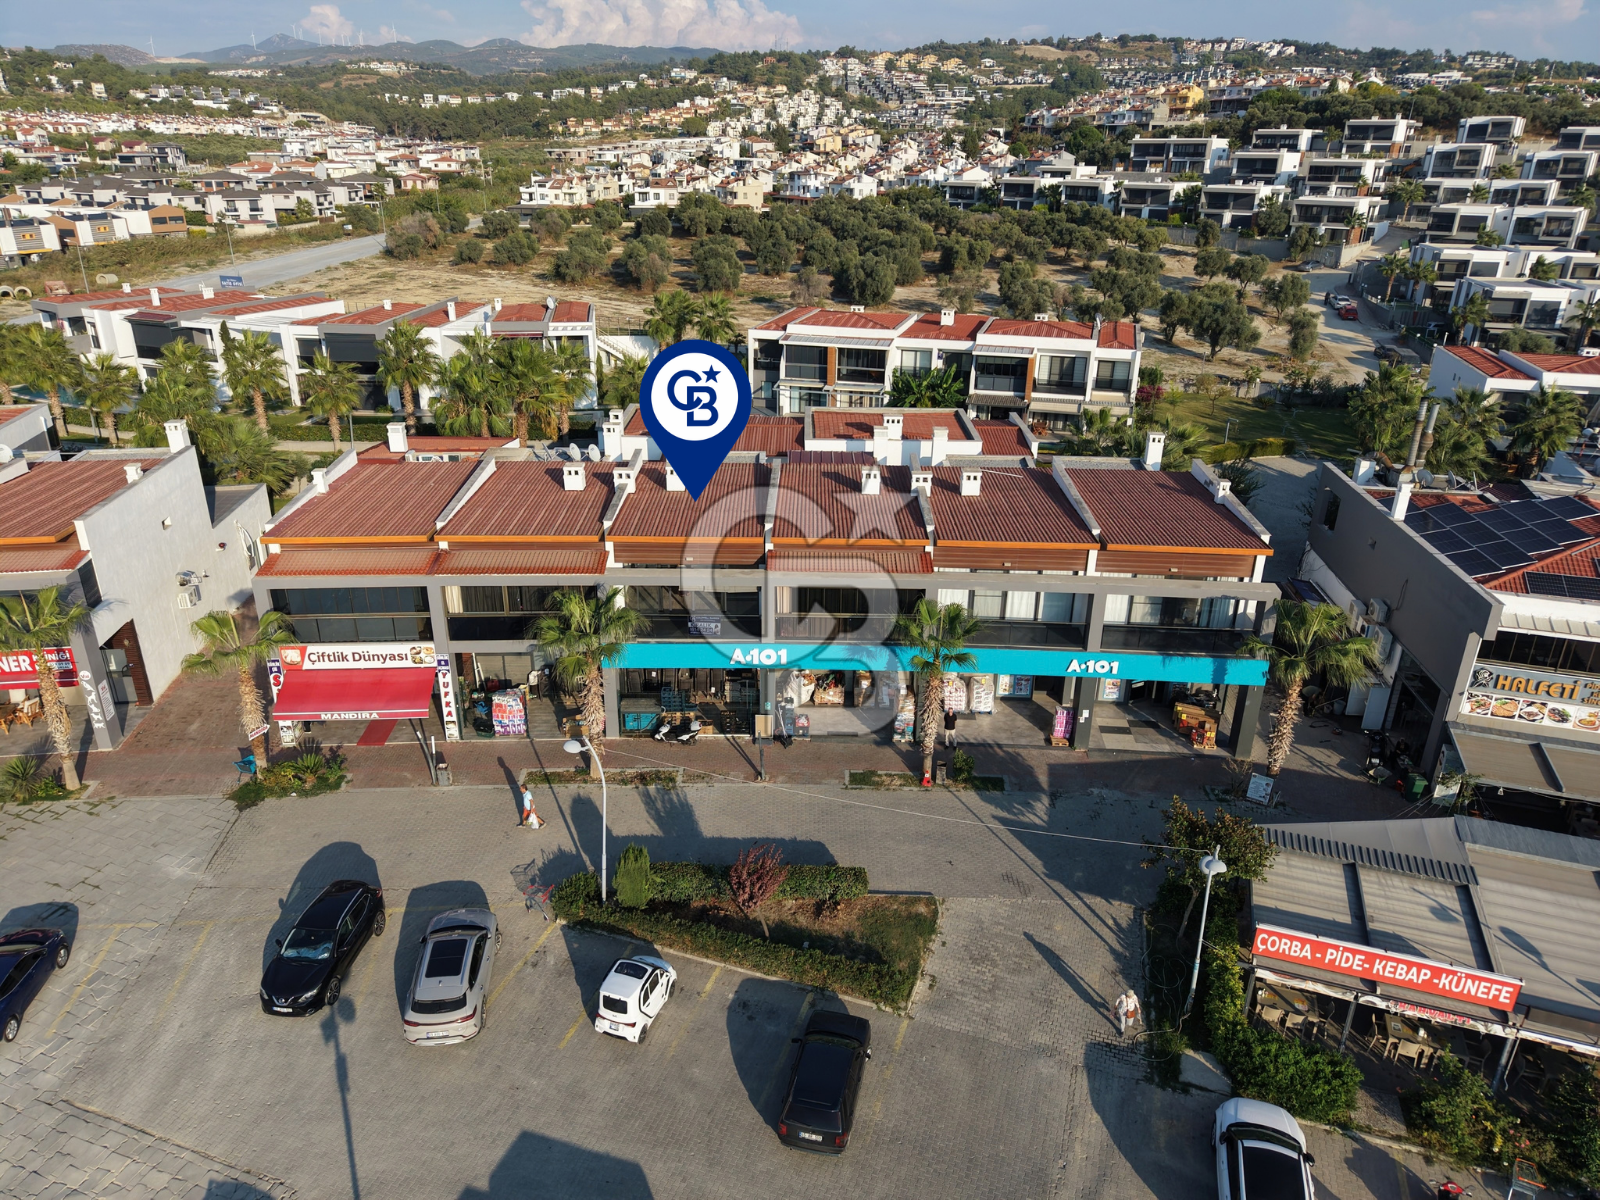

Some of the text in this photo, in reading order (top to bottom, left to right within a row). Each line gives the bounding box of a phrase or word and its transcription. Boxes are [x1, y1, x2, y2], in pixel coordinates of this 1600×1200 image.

[307, 651, 409, 665] Çiftlik Dünyası
[441, 671, 453, 718] YUFKA
[1496, 674, 1582, 700] HALFETİ
[1257, 933, 1312, 960] ÇORBA
[1373, 958, 1431, 984] KEBAP
